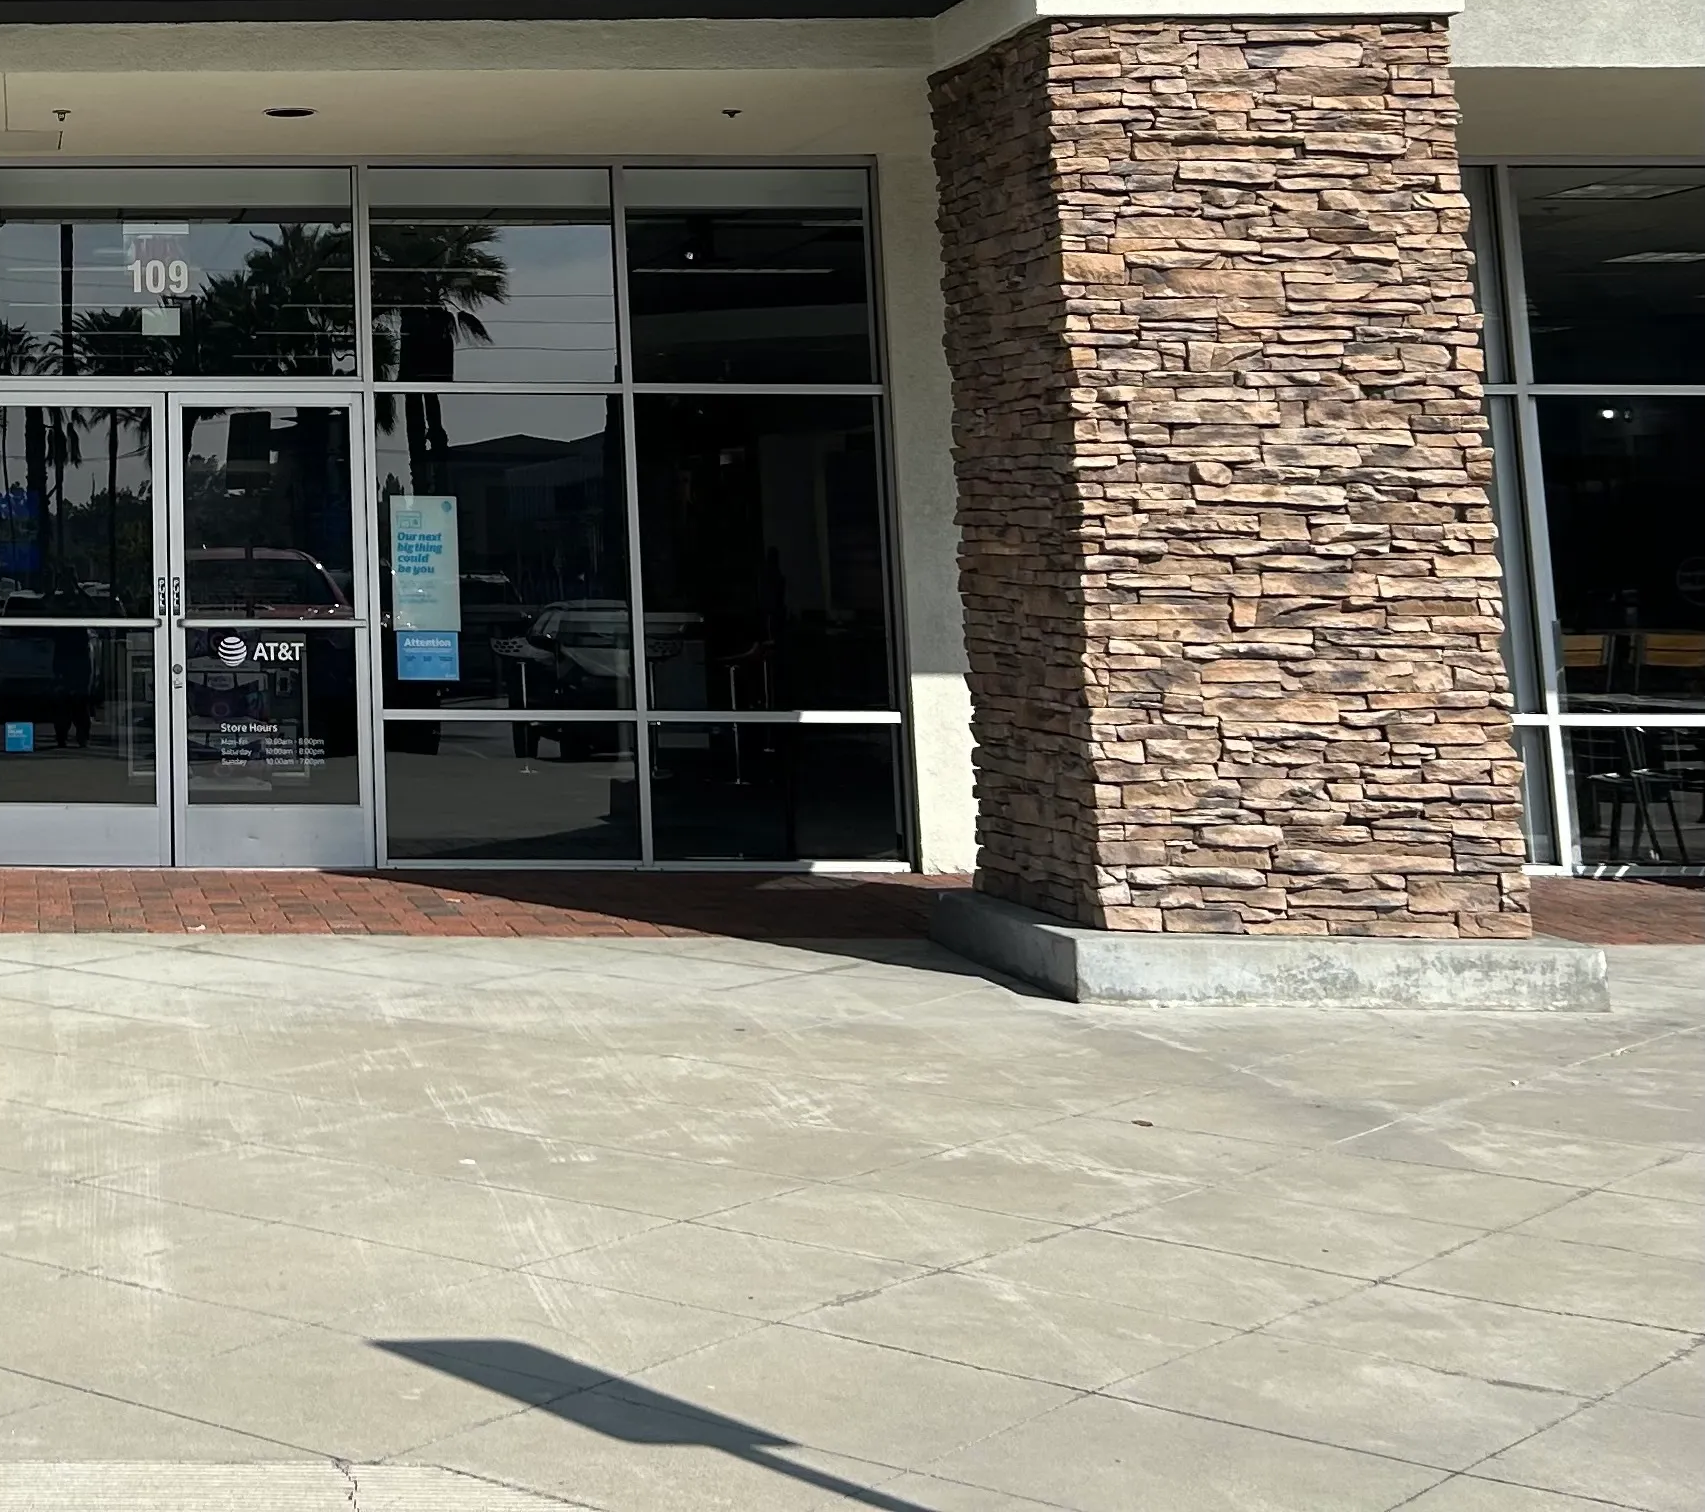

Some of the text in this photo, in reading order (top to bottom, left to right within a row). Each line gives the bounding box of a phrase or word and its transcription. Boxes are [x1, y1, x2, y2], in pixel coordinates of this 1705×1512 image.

[127, 259, 189, 294] 109
[397, 532, 442, 541] Our next
[397, 542, 443, 555] big thing
[397, 553, 430, 563] could
[397, 564, 435, 576] be you
[403, 637, 452, 647] Attention
[253, 642, 305, 661] AT&T
[220, 722, 278, 733] Store Hours
[220, 747, 252, 757] Saturday
[221, 757, 248, 767] Sunday
